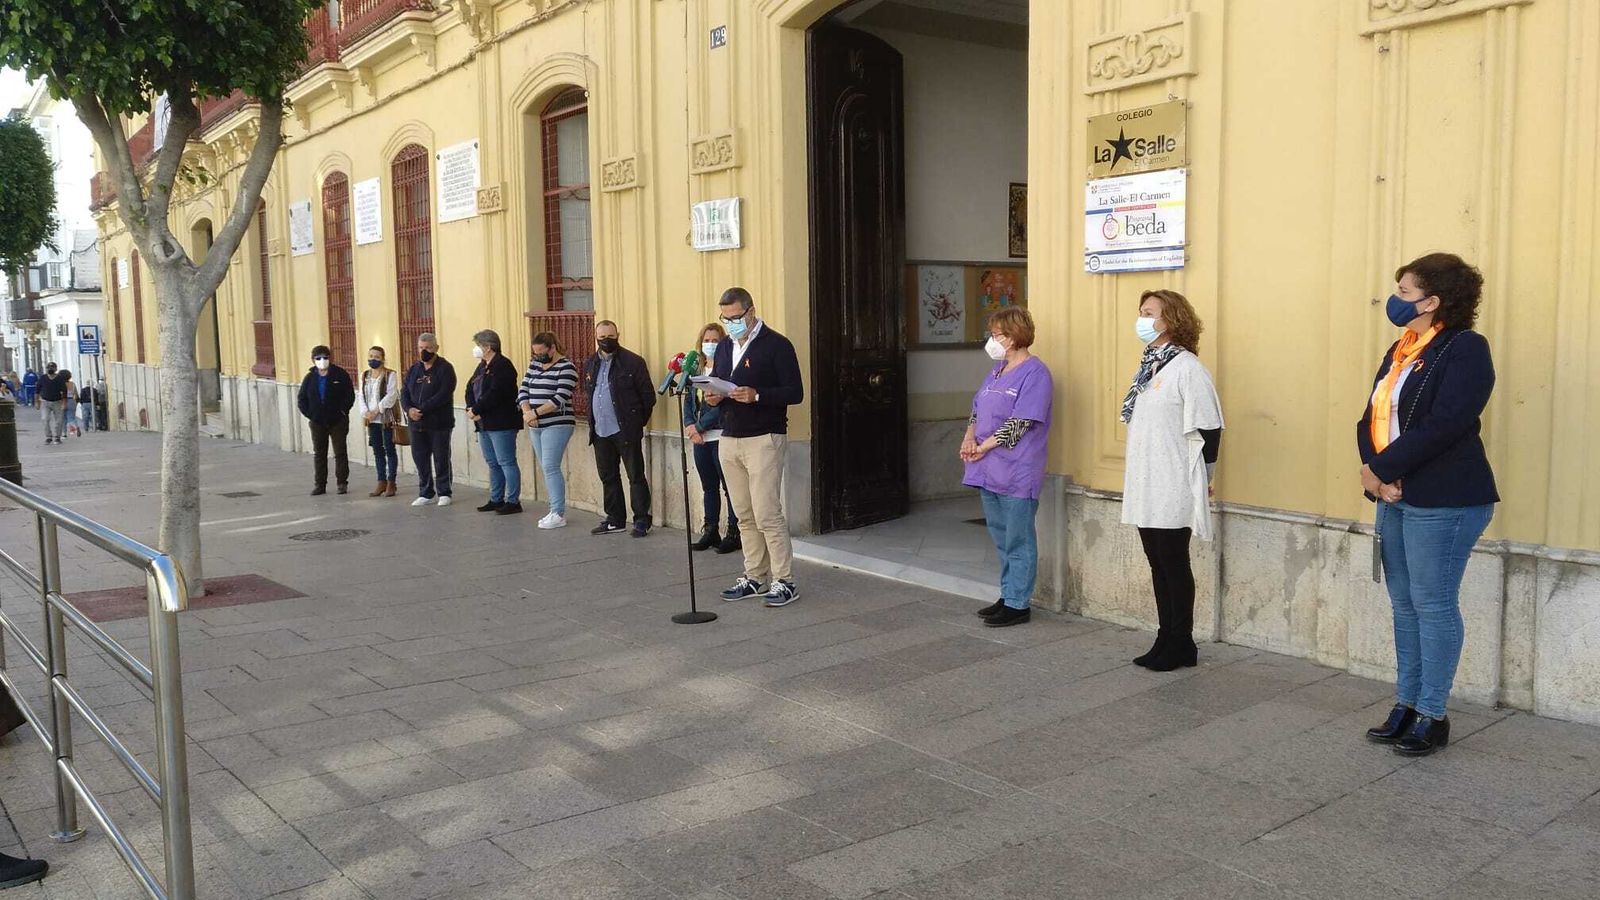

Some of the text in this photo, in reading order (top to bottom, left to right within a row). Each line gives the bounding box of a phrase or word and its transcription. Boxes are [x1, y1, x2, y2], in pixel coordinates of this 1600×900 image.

[711, 27, 726, 47] 129
[1116, 109, 1153, 122] COLEGIO
[1094, 134, 1176, 164] La Salle
[1134, 155, 1170, 167] El Carmen
[1099, 197, 1108, 206] La
[1139, 191, 1171, 202] Carmen
[1125, 212, 1167, 237] beda
